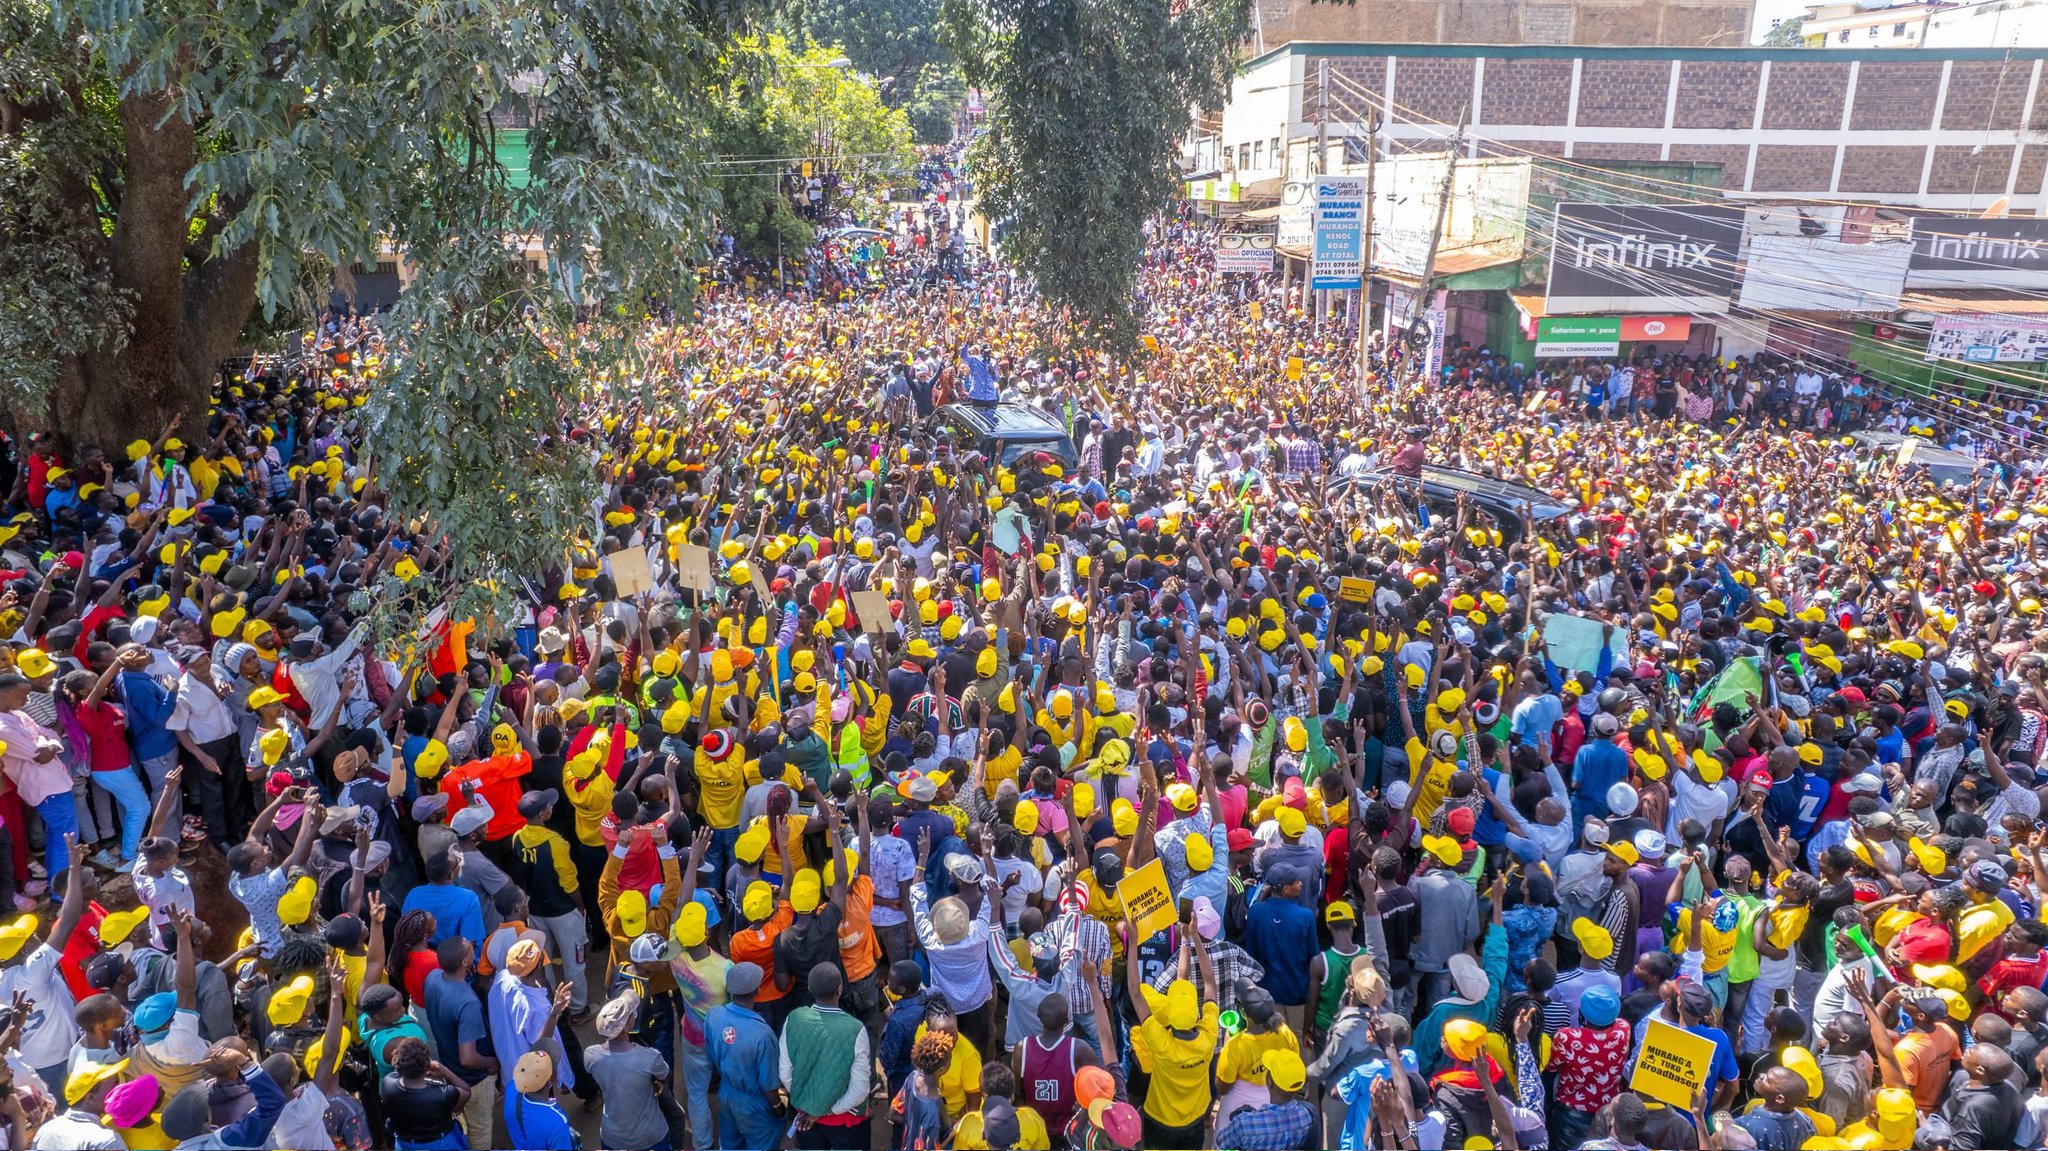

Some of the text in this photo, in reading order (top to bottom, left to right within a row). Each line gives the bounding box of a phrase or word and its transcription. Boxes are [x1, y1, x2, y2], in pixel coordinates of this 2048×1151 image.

[1318, 201, 1362, 209] MURANGA
[1322, 211, 1357, 219] BRANCH
[1575, 234, 1717, 269] Infinix
[1929, 231, 2045, 259] Infinix
[1433, 311, 1446, 349] CYBER
[1551, 326, 1586, 334] Safaricom
[1648, 323, 1662, 332] itel
[1127, 886, 1158, 909] MURANG'A
[1140, 896, 1155, 910] TUKO
[1131, 896, 1170, 923] roadbased
[1141, 946, 1156, 955] Dos
[1646, 1045, 1692, 1069] MURANG'A
[1660, 1059, 1682, 1073] TUKO
[1640, 1060, 1699, 1091] Broadbased
[1034, 1079, 1059, 1102] 21
